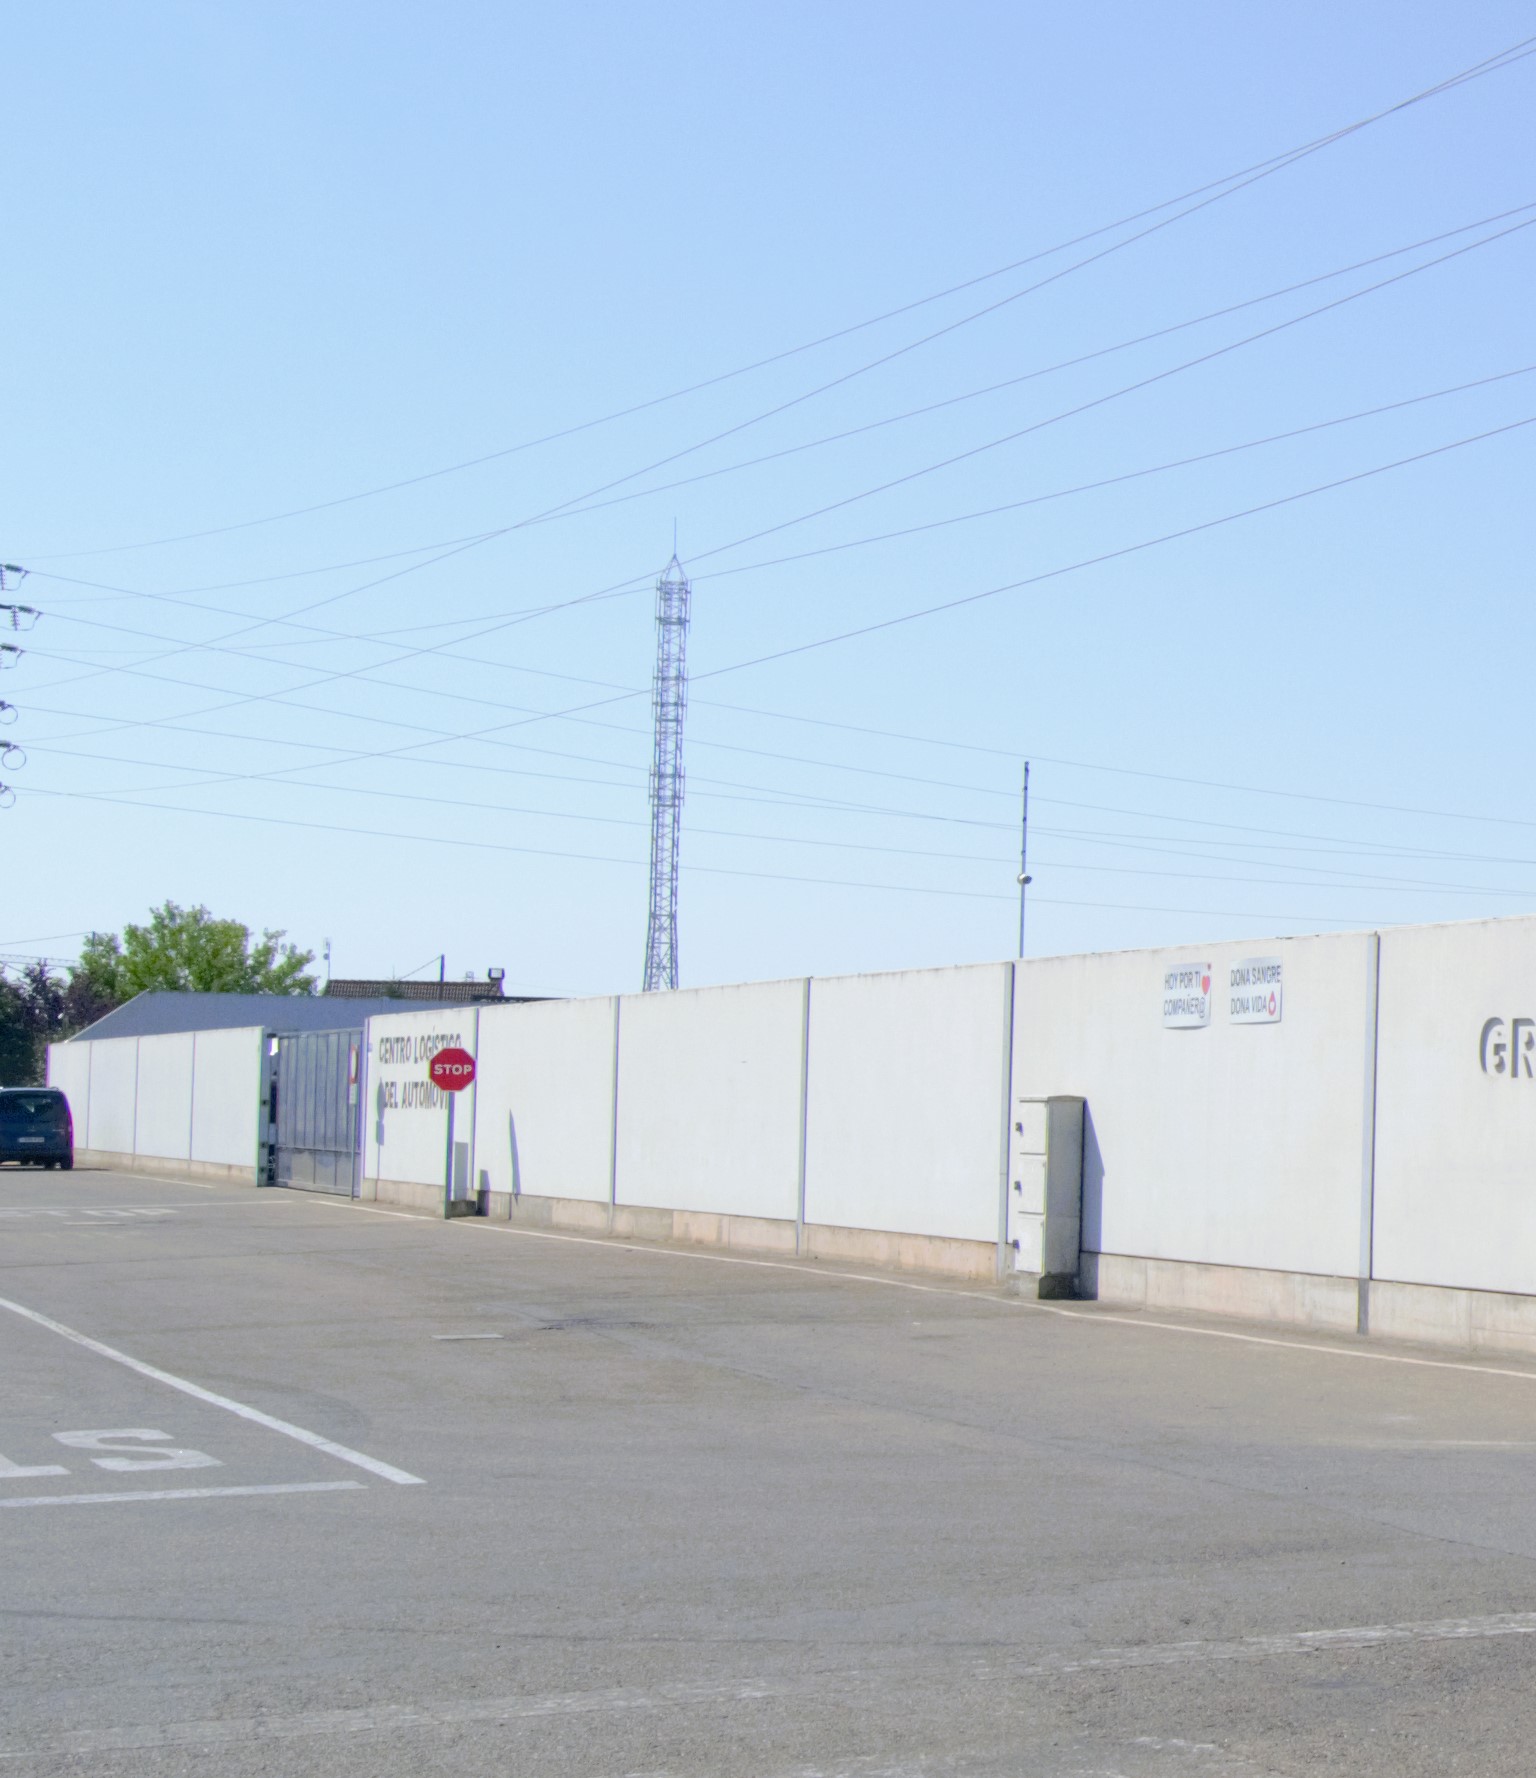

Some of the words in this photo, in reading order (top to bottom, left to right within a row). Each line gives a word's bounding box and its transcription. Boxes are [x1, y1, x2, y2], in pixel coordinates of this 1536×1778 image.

[1165, 973, 1178, 990] HOY
[1180, 971, 1194, 989] POR
[1195, 971, 1201, 988] TI
[1231, 968, 1251, 987] DONA
[1252, 965, 1281, 985] SANGRE
[1231, 997, 1250, 1015] DONA
[1252, 995, 1267, 1013] VIDA
[380, 1036, 412, 1064] CENTRO
[434, 1064, 472, 1075] STOP
[384, 1081, 398, 1109] DEL
